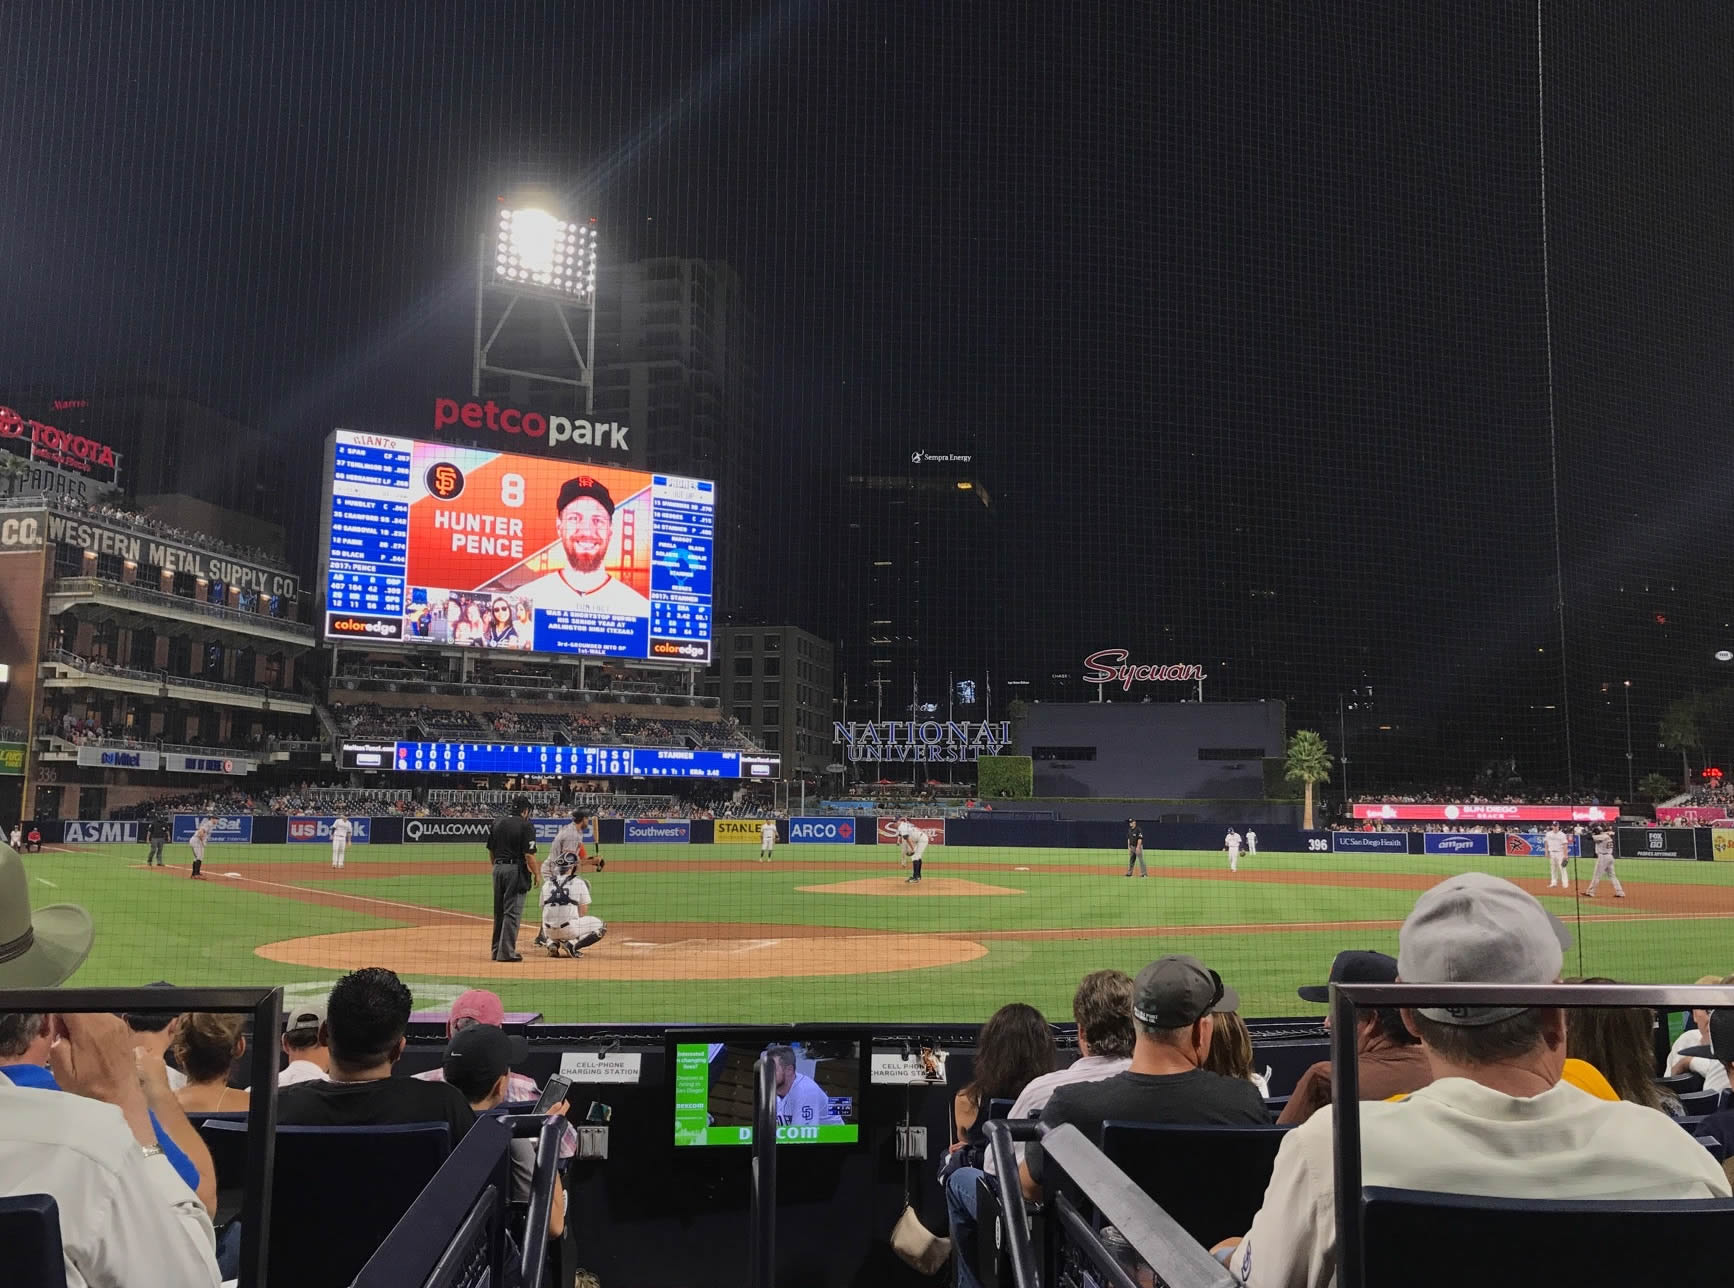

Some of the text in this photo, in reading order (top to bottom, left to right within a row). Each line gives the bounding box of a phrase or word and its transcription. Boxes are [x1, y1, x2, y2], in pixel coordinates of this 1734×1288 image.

[29, 419, 115, 469] TOYOTA
[353, 435, 397, 449] GIANTS
[924, 454, 972, 462] Sempra Energy
[19, 467, 87, 500] PADRES
[501, 472, 525, 508] 8
[434, 509, 524, 537] HUNTER
[1, 518, 43, 544] CO.
[452, 532, 524, 559] PENCE
[49, 515, 297, 599] WESTERN METAL SUPPLY CO.
[352, 564, 376, 572] PENCE
[1082, 648, 1208, 692] Sycuan
[416, 749, 423, 760] 0
[430, 750, 437, 760] 0
[444, 750, 451, 760] 0
[458, 750, 465, 760] 0
[540, 753, 548, 762] 0
[570, 754, 578, 763] 0
[586, 755, 593, 764] 5
[612, 751, 618, 760] S
[847, 744, 1004, 762] UNIVERSITY
[415, 760, 593, 774] 0 0 1 0 1 2 0 2
[600, 760, 630, 774] 1 0 1
[38, 767, 57, 782] 336
[1486, 806, 1518, 814] DIEGO
[66, 822, 138, 843] ASML
[406, 820, 492, 842] QUALCOMM
[628, 826, 680, 838] Southwest
[718, 823, 762, 833] STANLE
[791, 824, 837, 838] ARCO
[528, 841, 536, 850] 7
[1308, 838, 1328, 850] 396
[1363, 838, 1380, 848] Diego
[1438, 840, 1474, 852] ampm
[738, 1126, 818, 1140] Dcom
